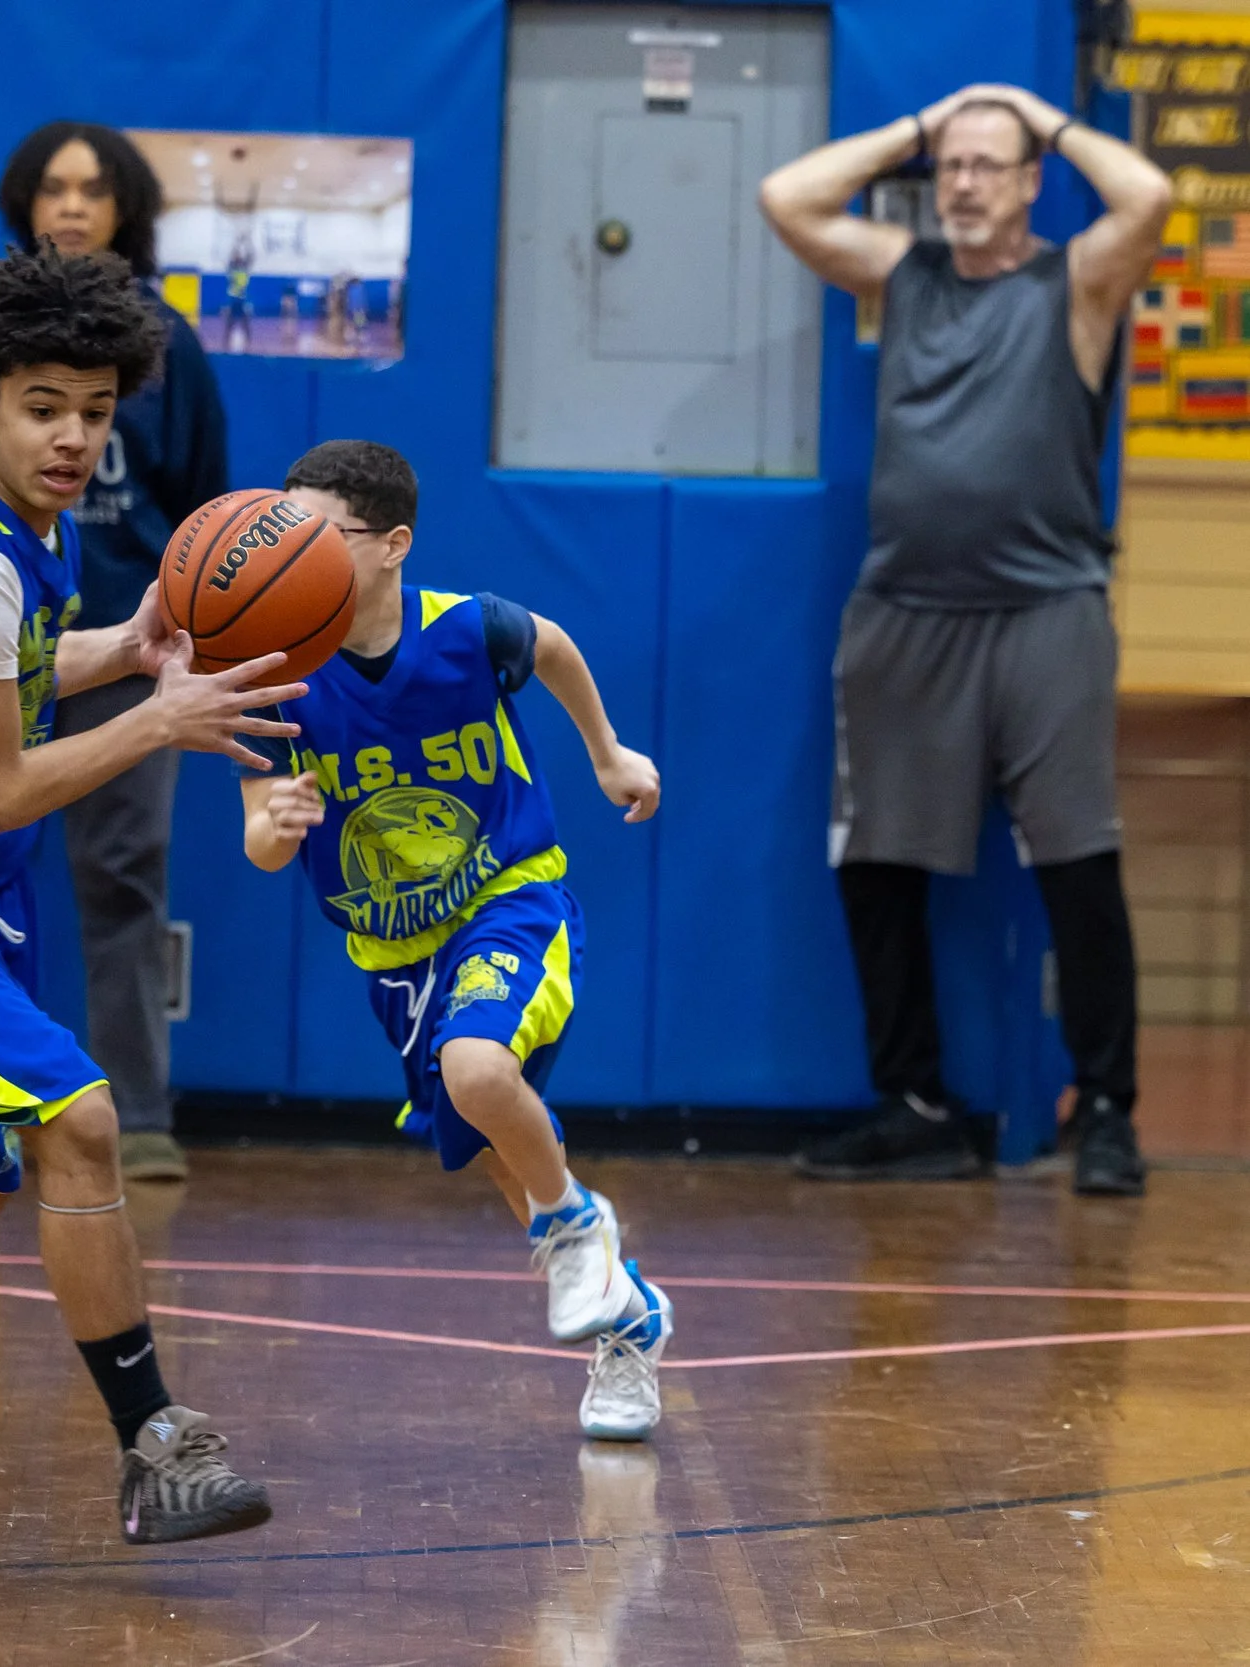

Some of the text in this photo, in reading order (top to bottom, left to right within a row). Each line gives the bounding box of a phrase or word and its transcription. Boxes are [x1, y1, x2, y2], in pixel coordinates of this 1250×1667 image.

[208, 499, 314, 592] Wilson
[421, 721, 497, 785] 50
[490, 951, 519, 974] 50
